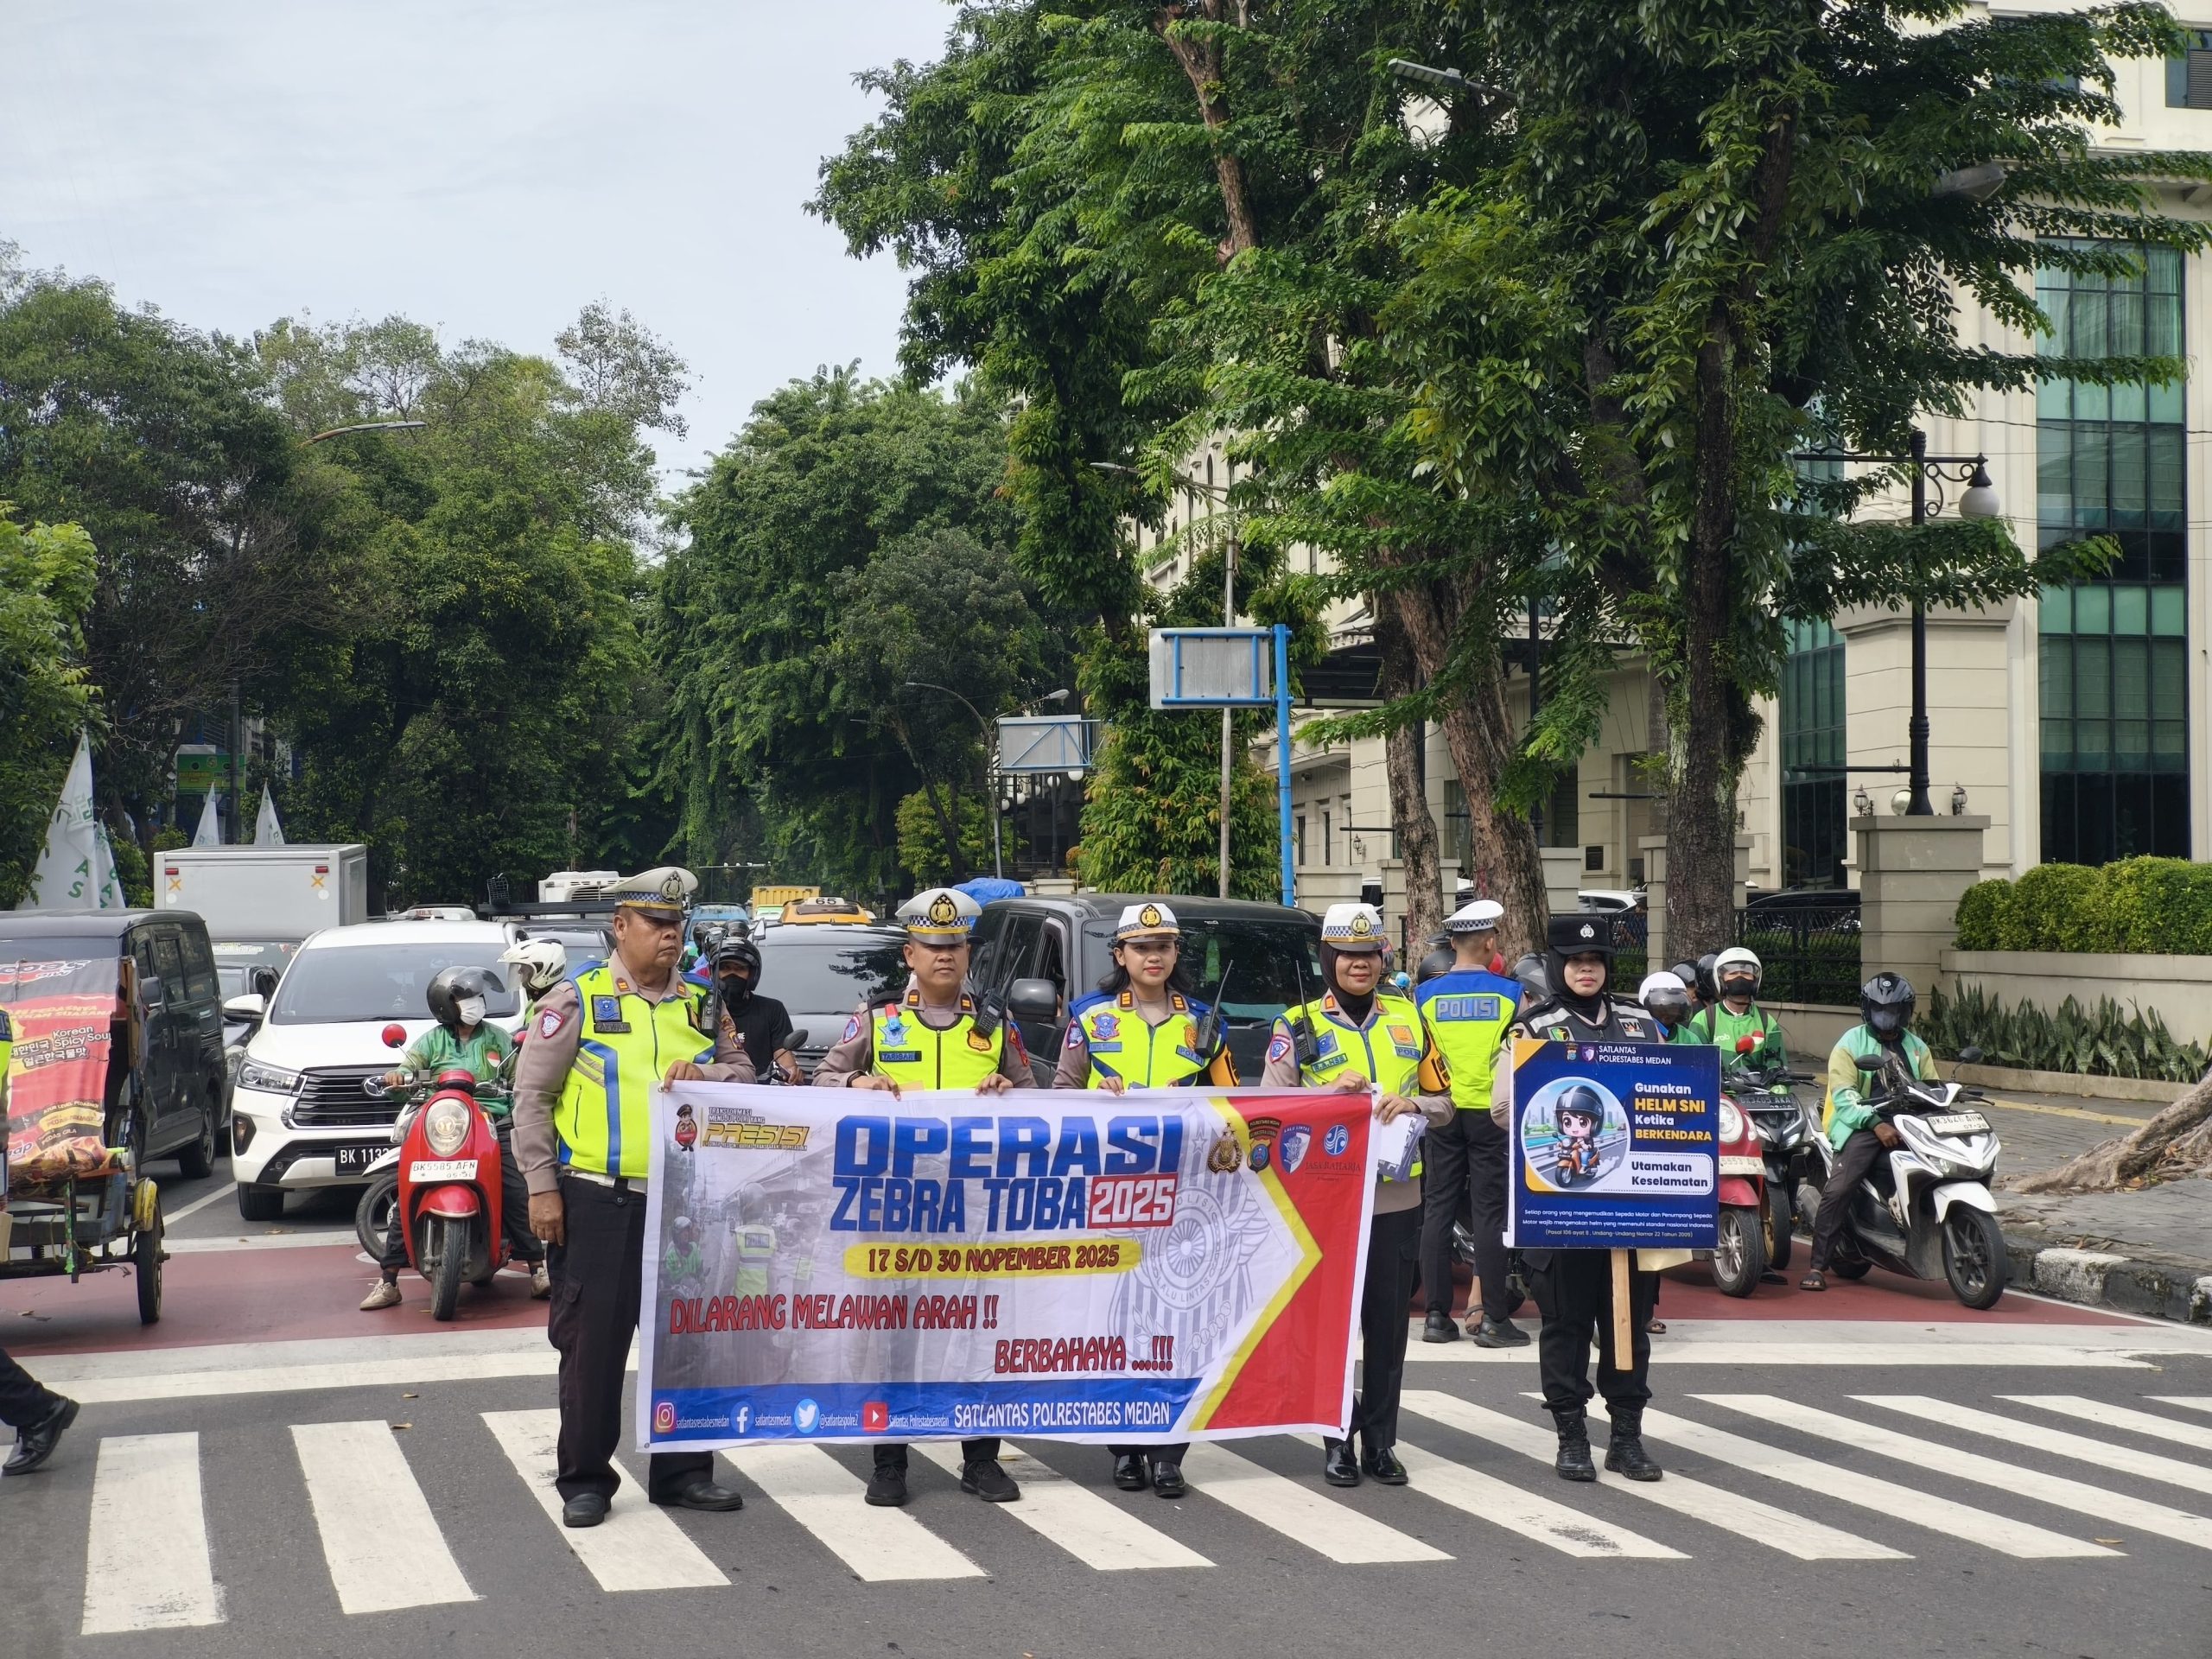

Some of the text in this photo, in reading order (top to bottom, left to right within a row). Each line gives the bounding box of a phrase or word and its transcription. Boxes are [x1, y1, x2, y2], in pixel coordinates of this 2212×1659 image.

[1437, 998, 1499, 1019] POLISI
[53, 1026, 93, 1039] Korean
[54, 1036, 86, 1048] Spicy
[1599, 1046, 1637, 1054] SATLANTAS
[1599, 1054, 1644, 1064] POLRESTABES
[1634, 1082, 1692, 1094] Gunakan
[709, 1107, 753, 1116] TRANSFORMASI
[1635, 1098, 1707, 1113] HELM SNI
[1635, 1115, 1675, 1126] Ketika
[703, 1122, 810, 1146] PRESISI
[1635, 1128, 1713, 1141] BERKENDARA
[833, 1115, 1184, 1179] OPERASI
[340, 1148, 356, 1164] BK
[1631, 1161, 1693, 1172] Utamakan
[1631, 1176, 1709, 1187] Keselamatan
[830, 1176, 1177, 1233] ZEBRA TOBA 2025
[1176, 1194, 1217, 1213] OLISI
[868, 1244, 1121, 1272] 17 S/D 30 NOPEMBER 2025
[1157, 1277, 1211, 1302] LALU LINTAS
[670, 1294, 1000, 1334] DILARANG MELAWAN ARAH !!
[994, 1335, 1127, 1374] BERBAHAYA
[953, 1401, 1170, 1428] SATLANTAS POLRESTABES MEDAN
